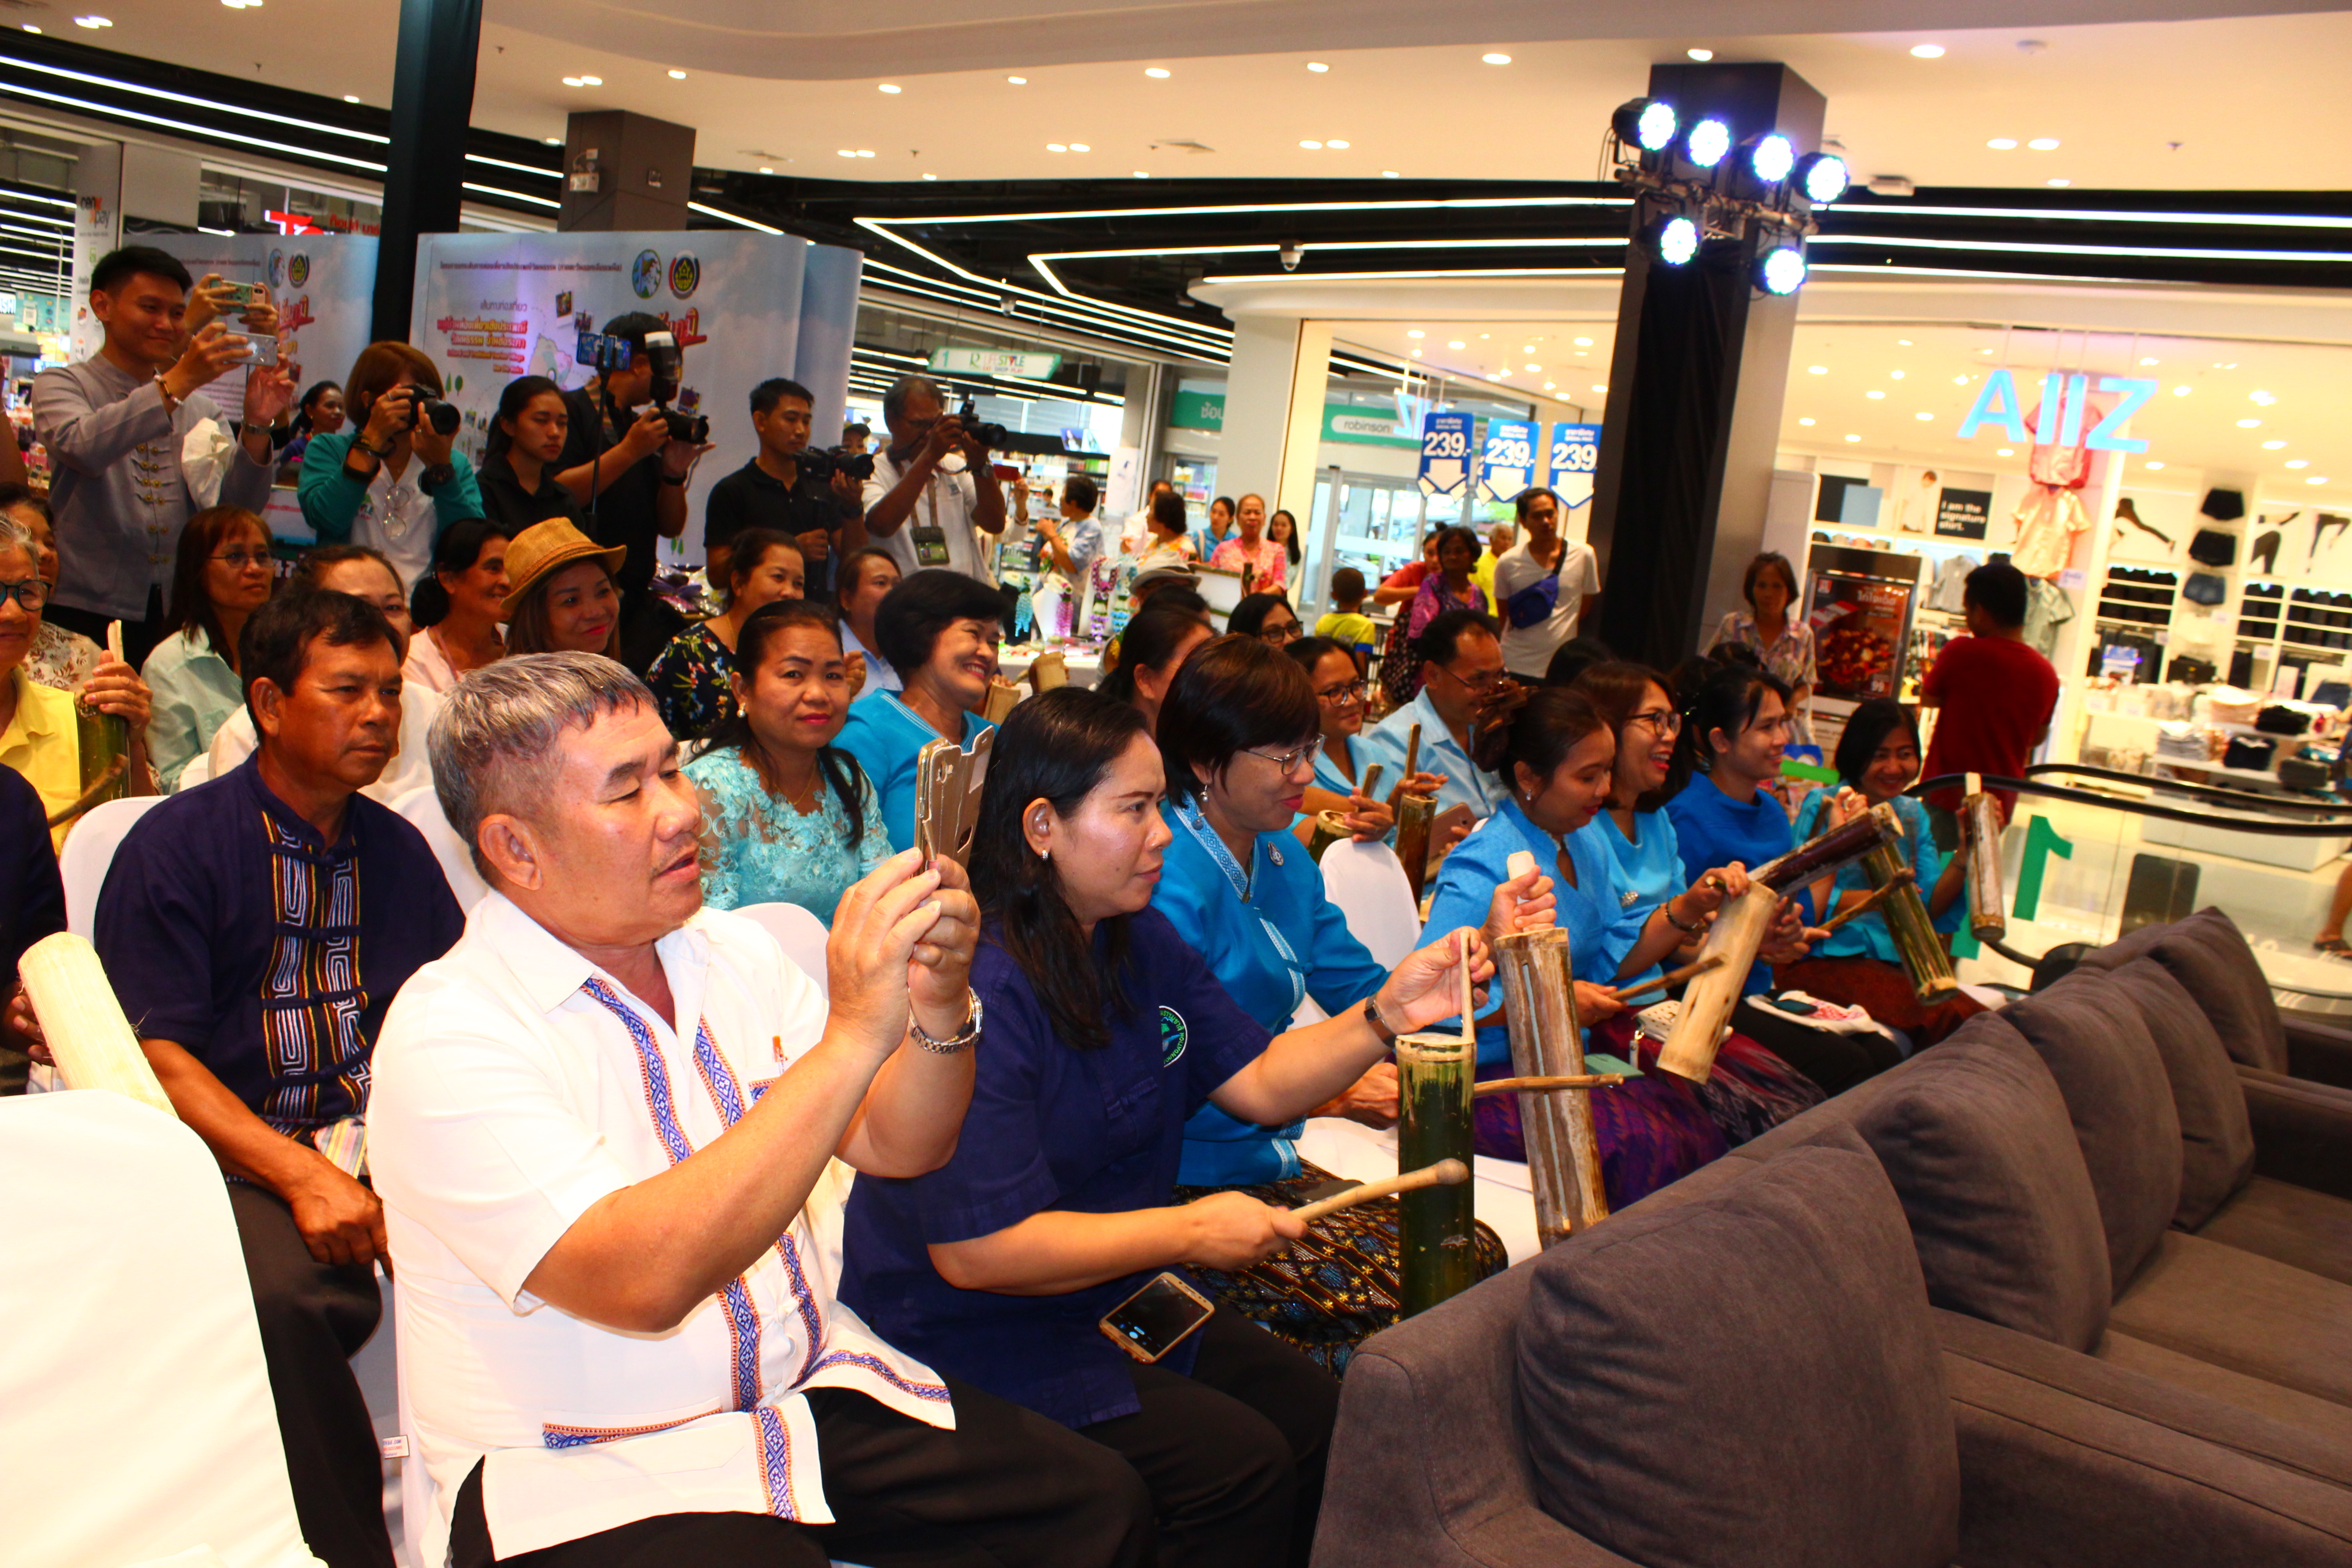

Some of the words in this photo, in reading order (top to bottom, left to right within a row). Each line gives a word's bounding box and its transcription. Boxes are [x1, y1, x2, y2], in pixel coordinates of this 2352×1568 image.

[1344, 421, 1390, 433] robinson
[1941, 500, 1947, 510] I
[1947, 502, 1964, 511] am
[1965, 503, 1982, 514] the
